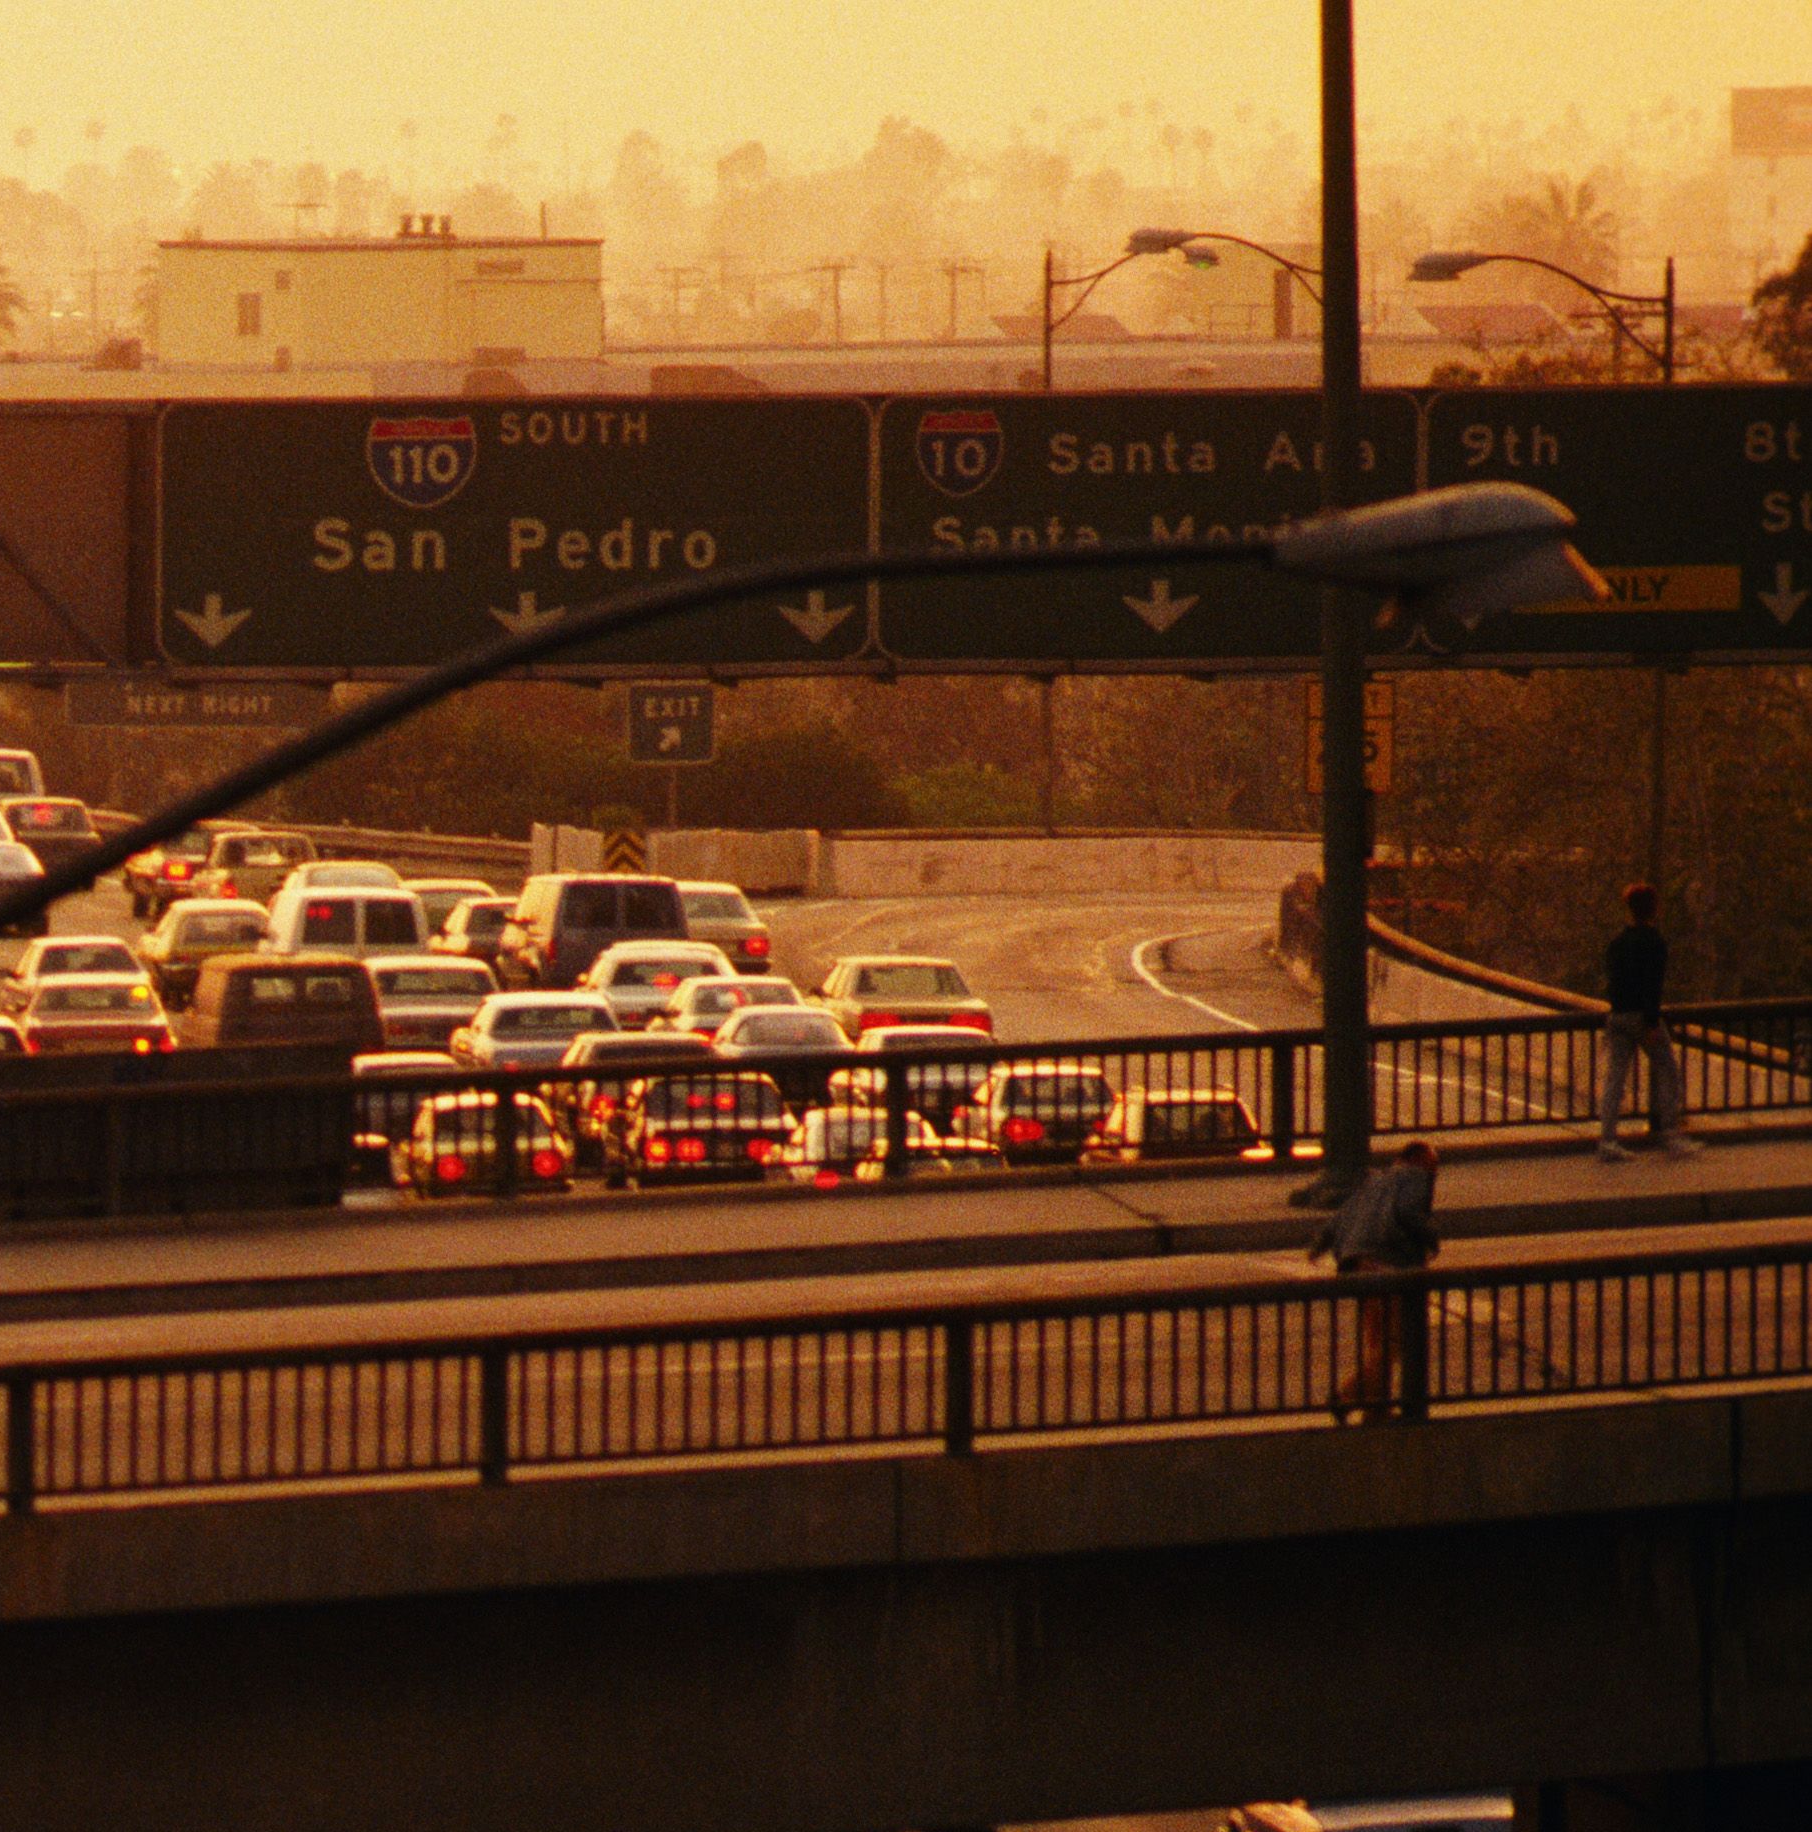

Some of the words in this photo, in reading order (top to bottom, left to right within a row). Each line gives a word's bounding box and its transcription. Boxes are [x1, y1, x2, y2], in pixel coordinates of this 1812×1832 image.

[497, 409, 649, 446] SOUTH
[1461, 423, 1561, 468] 9th
[387, 443, 458, 486] 110
[928, 436, 988, 478] 10
[1048, 432, 1220, 476] Santa
[311, 517, 447, 573] San
[506, 517, 718, 571] Pedro
[929, 513, 1100, 553] Santa
[1606, 574, 1670, 604] NLY
[126, 694, 186, 715] NEXT
[201, 693, 273, 715] RIGHT
[644, 695, 701, 718] EXIT
